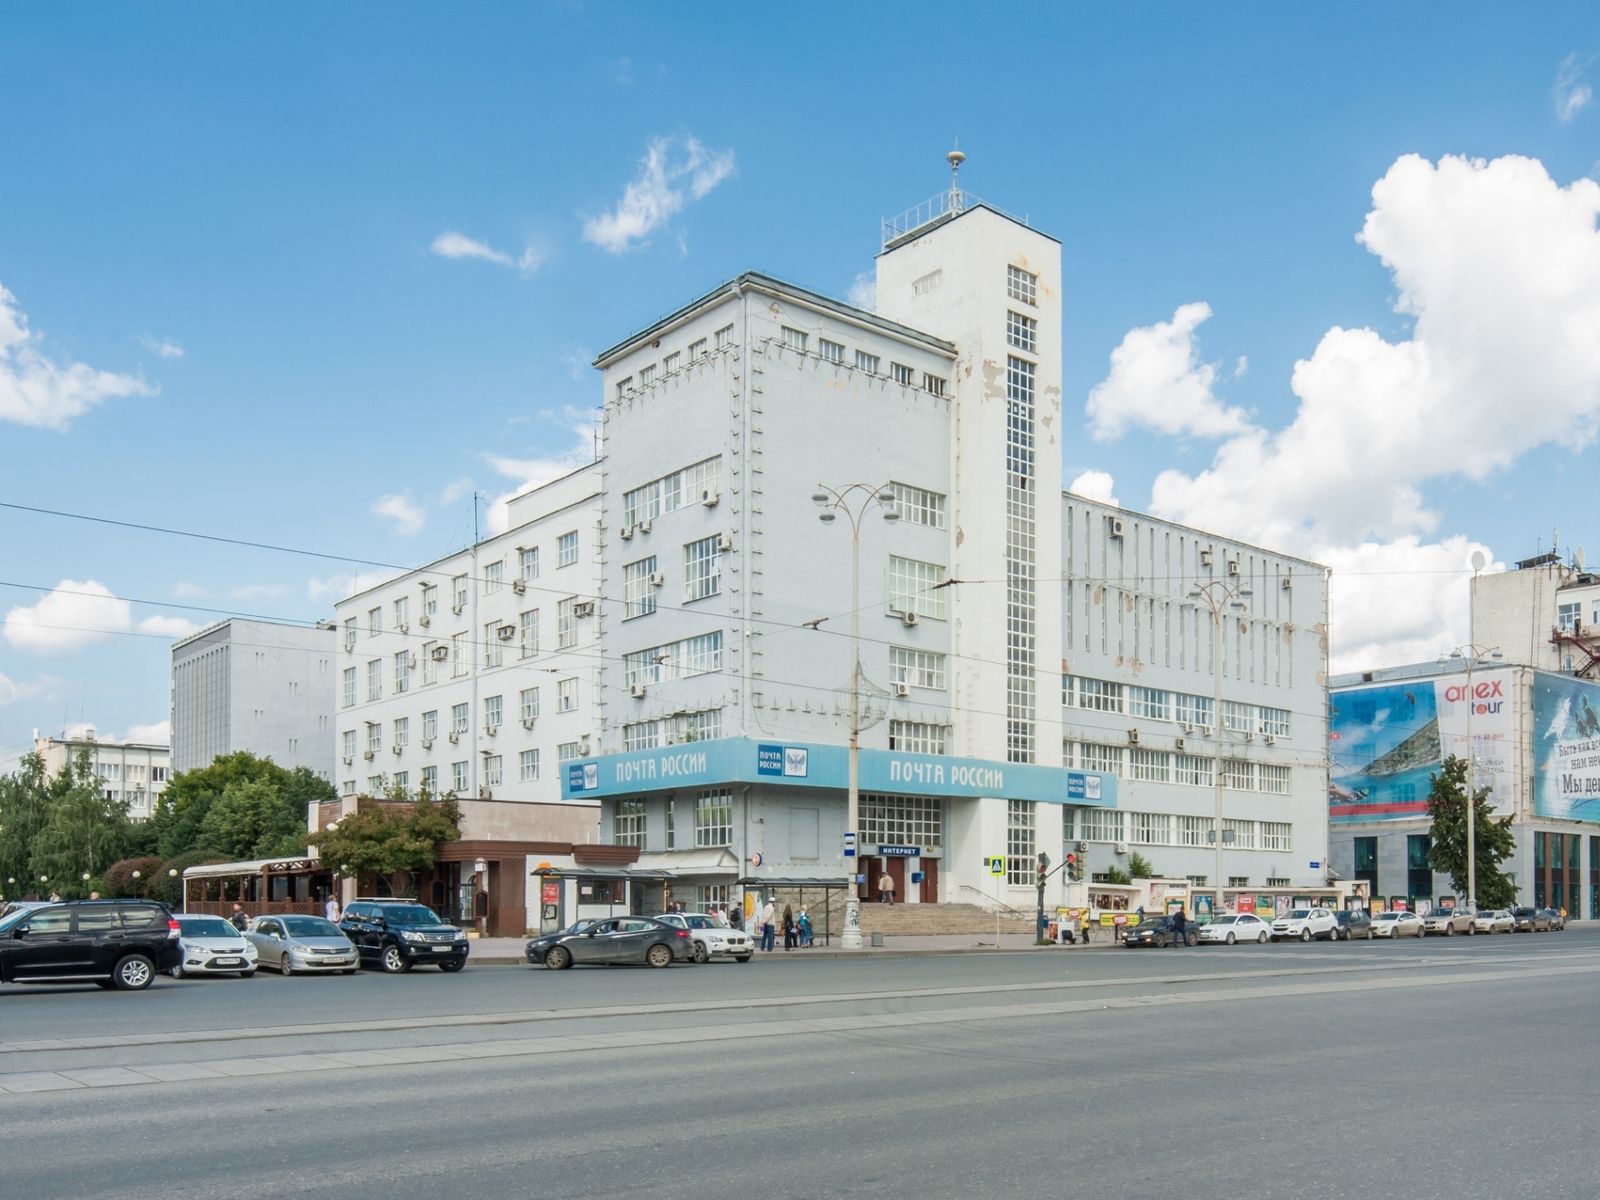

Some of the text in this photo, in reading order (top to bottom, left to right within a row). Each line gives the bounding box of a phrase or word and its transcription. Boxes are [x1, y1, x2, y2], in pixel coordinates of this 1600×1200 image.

[1445, 680, 1503, 702] anex
[1471, 701, 1504, 715] tour
[759, 751, 781, 760] ПОЧТА
[1571, 757, 1588, 770] нам
[616, 752, 707, 782] ПОЧТА РОССИИ
[759, 760, 782, 770] РОССИИ
[890, 760, 1003, 789] ПОЧТА РОССИИ
[1562, 774, 1583, 793] Мы
